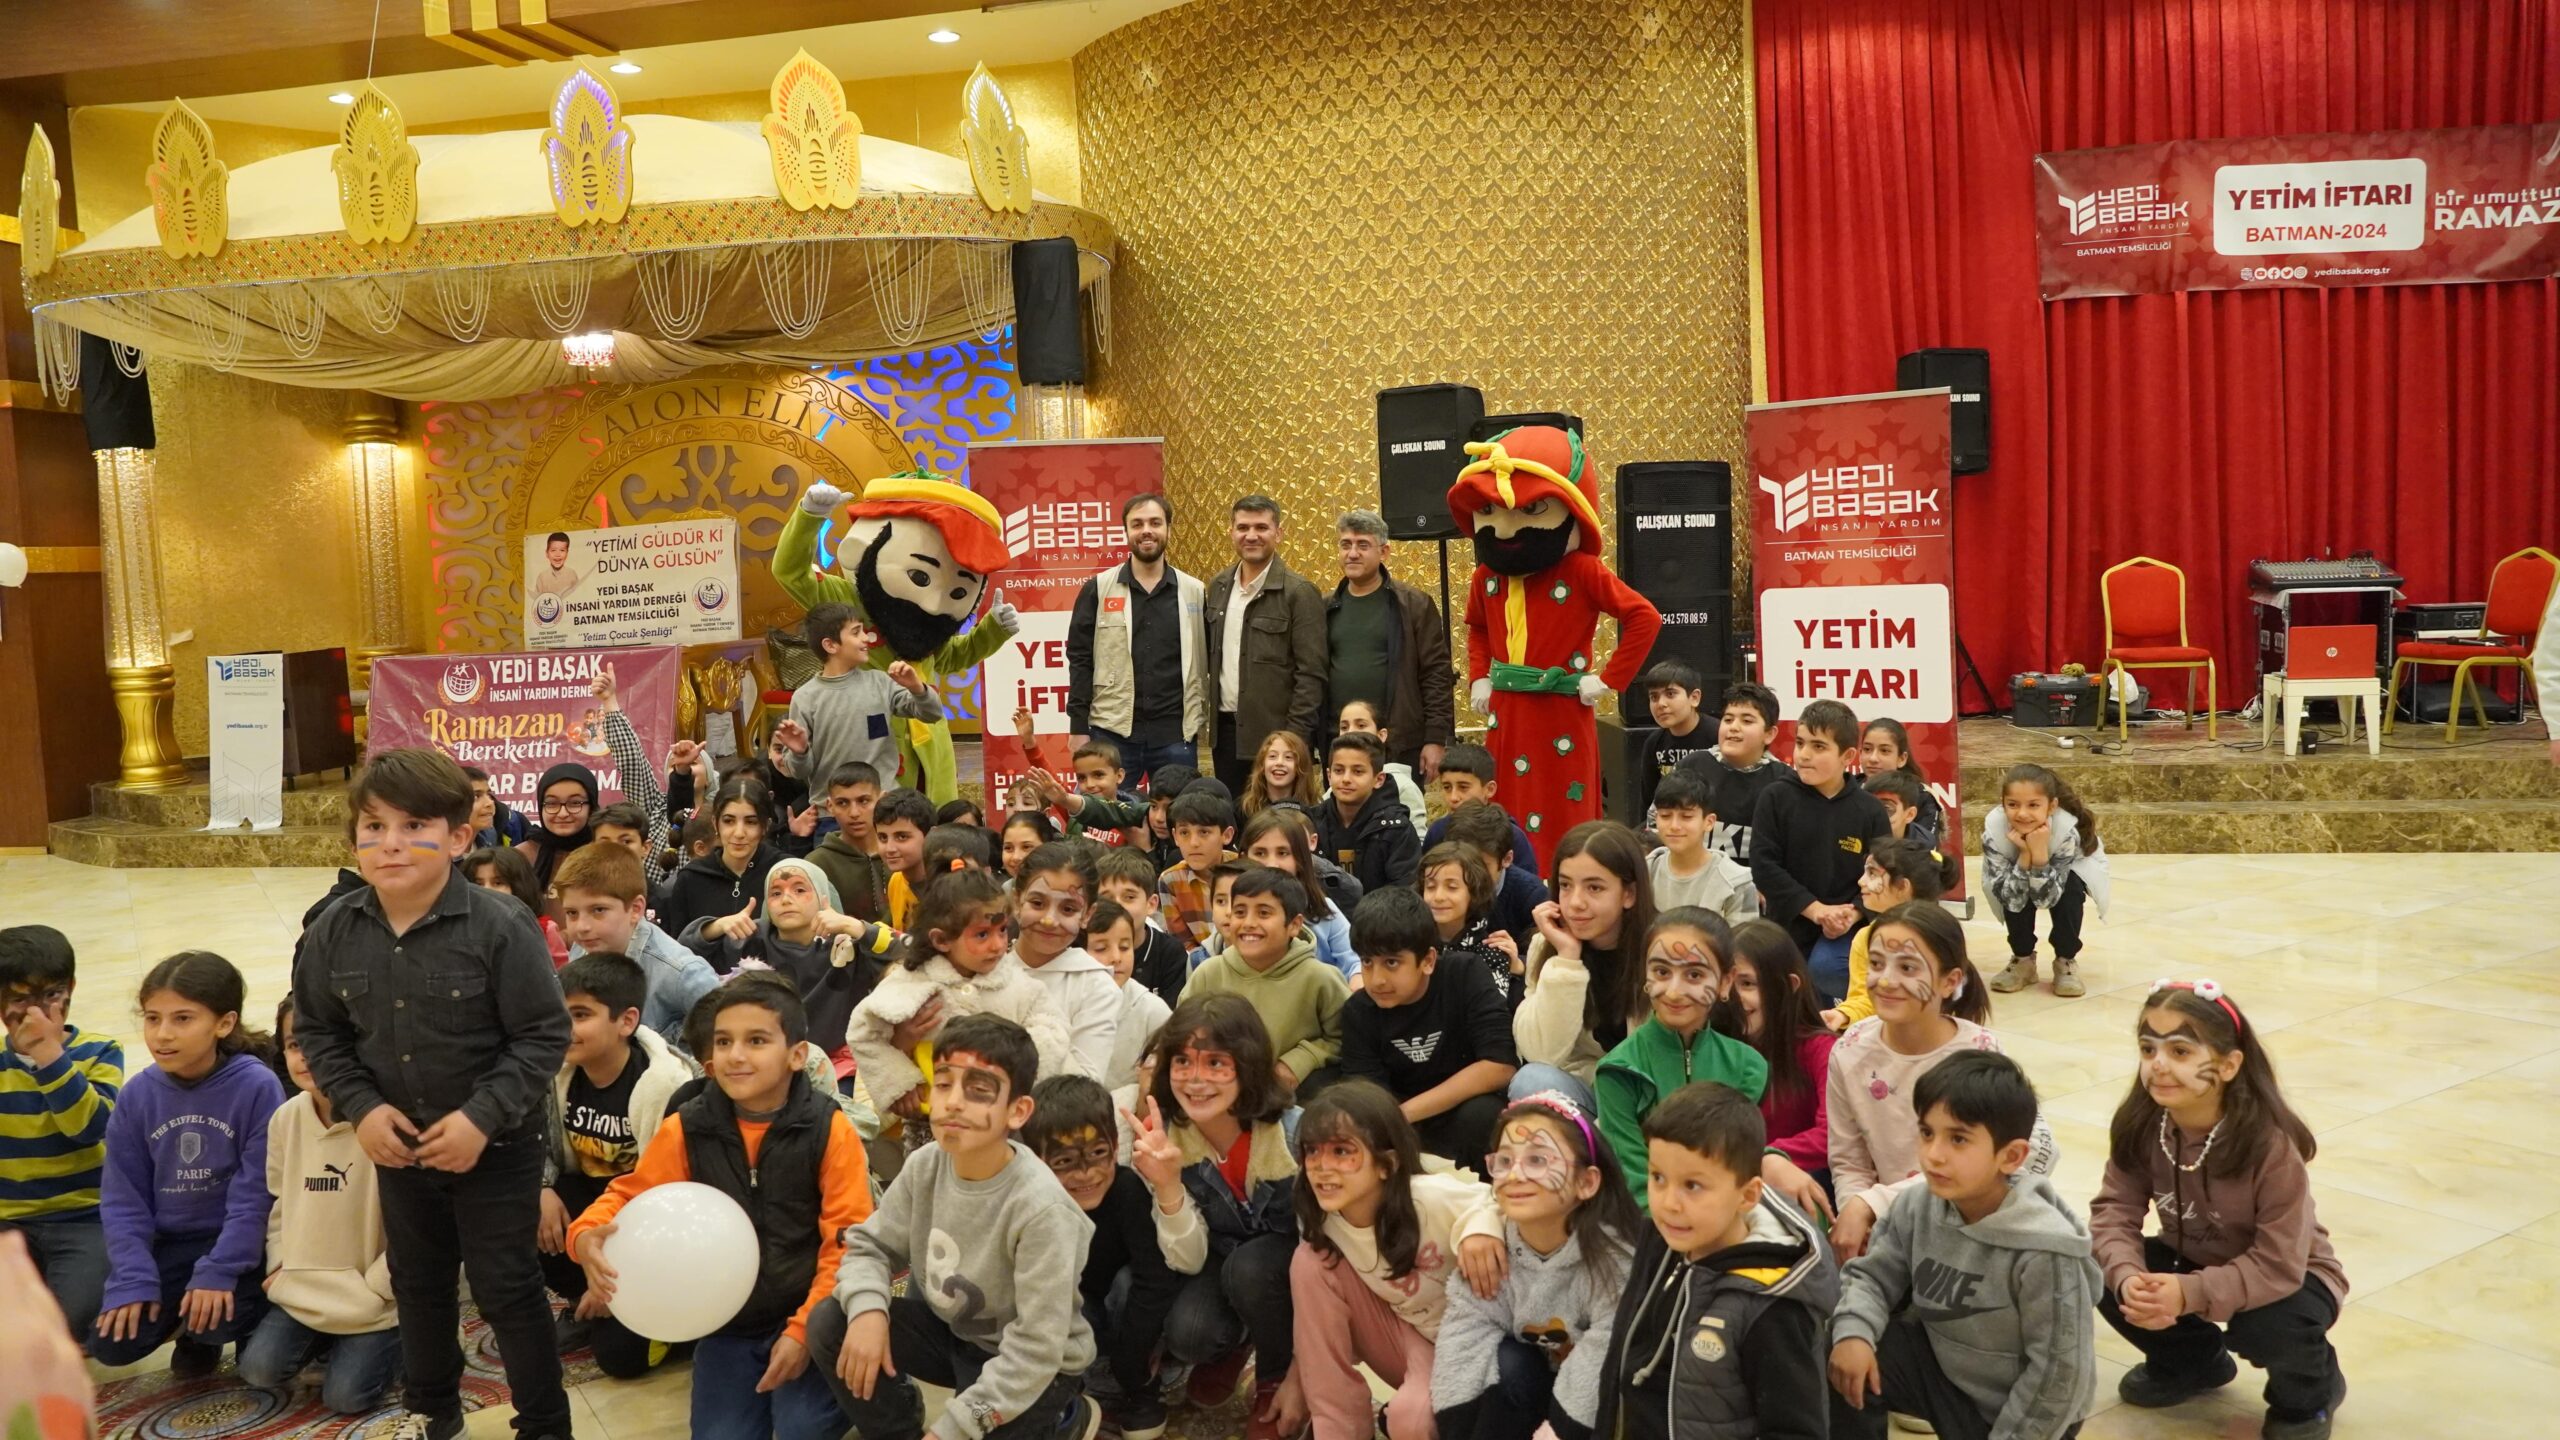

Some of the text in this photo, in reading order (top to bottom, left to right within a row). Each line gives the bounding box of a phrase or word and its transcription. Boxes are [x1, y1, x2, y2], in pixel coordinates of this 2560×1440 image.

[2228, 180, 2412, 211] YETİM İFTARI
[2434, 189, 2466, 206] bir
[2246, 223, 2387, 242] BATMAN-2024
[2077, 246, 2116, 257] BATMAN
[2314, 266, 2391, 278] yedibasak.org.tr
[578, 385, 722, 457] SALON
[1391, 440, 1446, 456] ÇALIŞKAN SOUND
[1636, 513, 1716, 532] ÇALIŞKAN SOUND
[1878, 518, 1941, 529] YARDIM
[642, 528, 704, 549] GÜLDÜR
[709, 525, 723, 542] Kİ
[1033, 525, 1129, 549] BAŞA
[1784, 544, 1917, 562] BATMAN TEMSİLCİLİĞİ
[598, 555, 649, 574] DÜNYA
[596, 582, 654, 596] YEDİ BAŞAK
[1005, 578, 1056, 589] BATMAN
[603, 599, 641, 609] YARDIM
[643, 590, 687, 606] DERNEĞİ
[573, 614, 615, 626] BATMAN
[1676, 612, 1689, 624] 578
[1689, 612, 1699, 624] 08
[1699, 612, 1708, 624] 59
[609, 629, 638, 640] Çocuk
[1793, 608, 1917, 650] YETİM
[538, 654, 603, 683] BAŞAK
[1795, 660, 1919, 700] İFTARI
[523, 687, 559, 701] YARDIM
[561, 685, 593, 699] DERNE
[423, 708, 564, 748] Ramazan
[453, 736, 562, 763] Berekettir
[151, 1123, 169, 1140] THE
[168, 1114, 205, 1128] EIFFEL
[176, 1168, 212, 1180] PARIS
[304, 1177, 340, 1192] PUMA
[1914, 1257, 1984, 1310] NIKE
